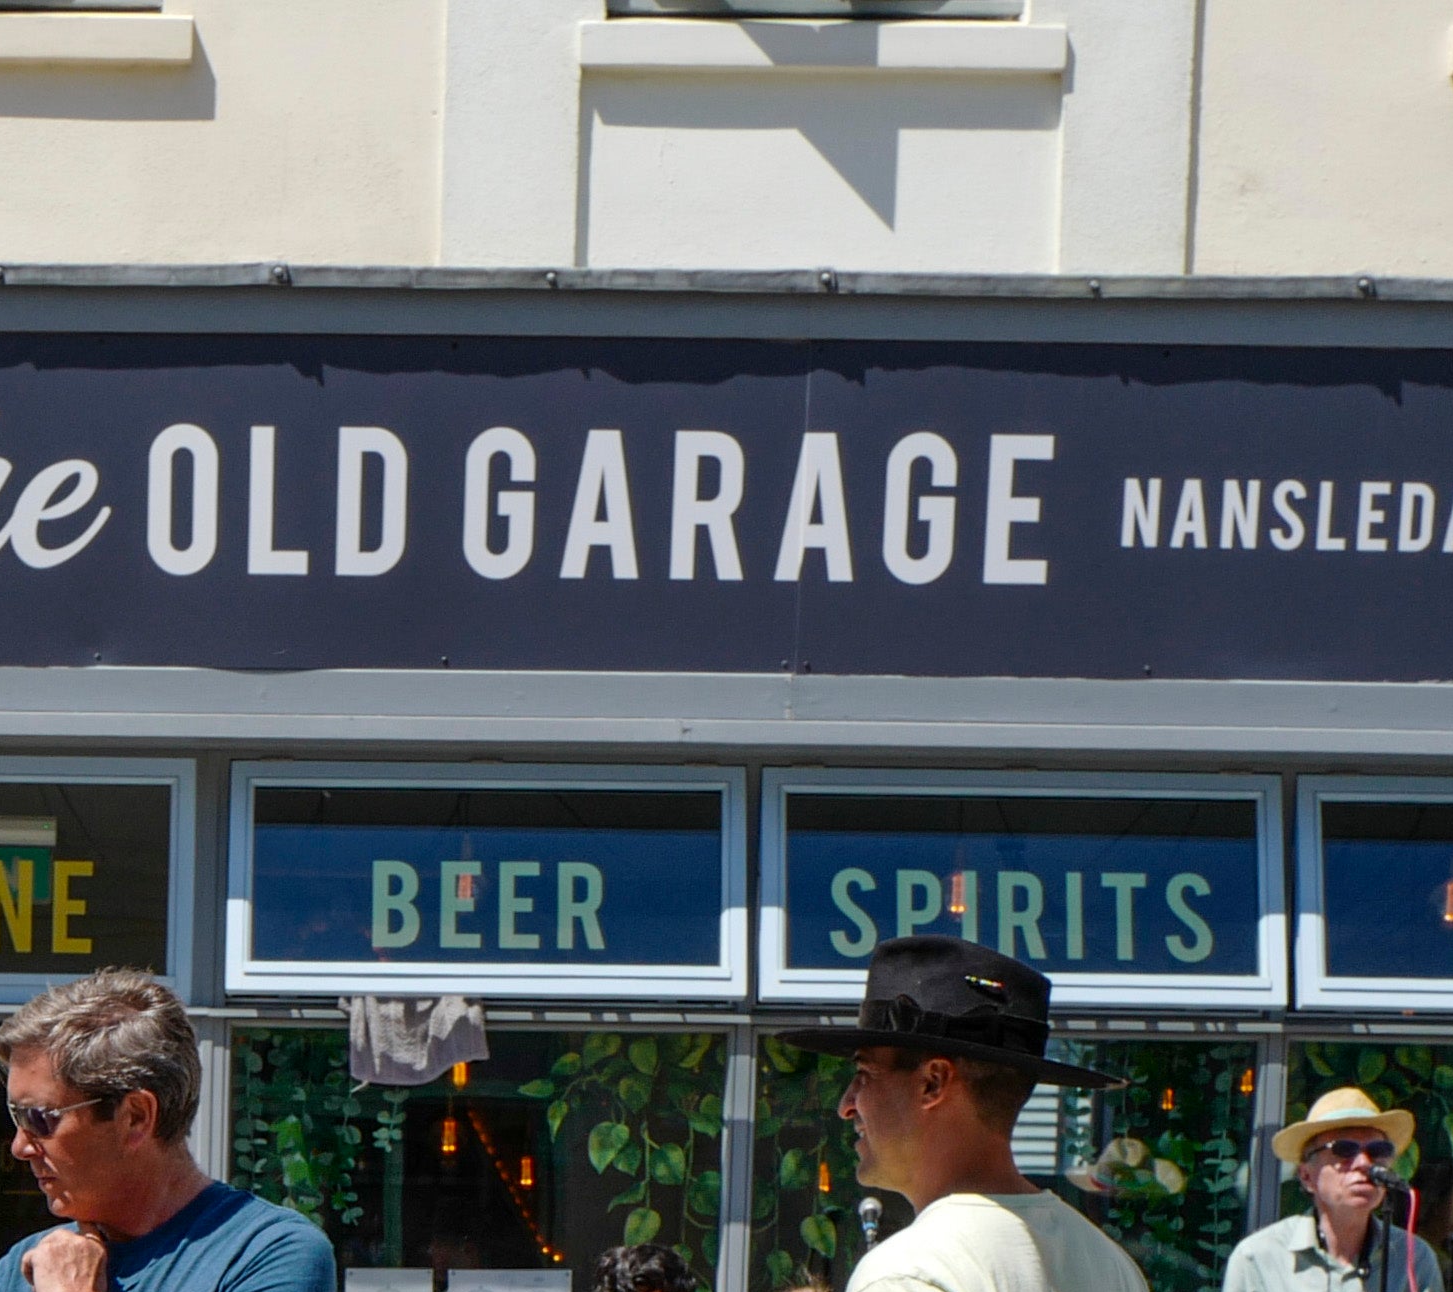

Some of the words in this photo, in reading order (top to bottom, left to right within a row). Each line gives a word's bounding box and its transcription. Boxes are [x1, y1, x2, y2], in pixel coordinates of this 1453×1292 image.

[146, 422, 410, 578] OLD
[462, 426, 1056, 586] GARAGE
[371, 860, 606, 950] BEER
[829, 867, 1215, 964] SPIRITS
